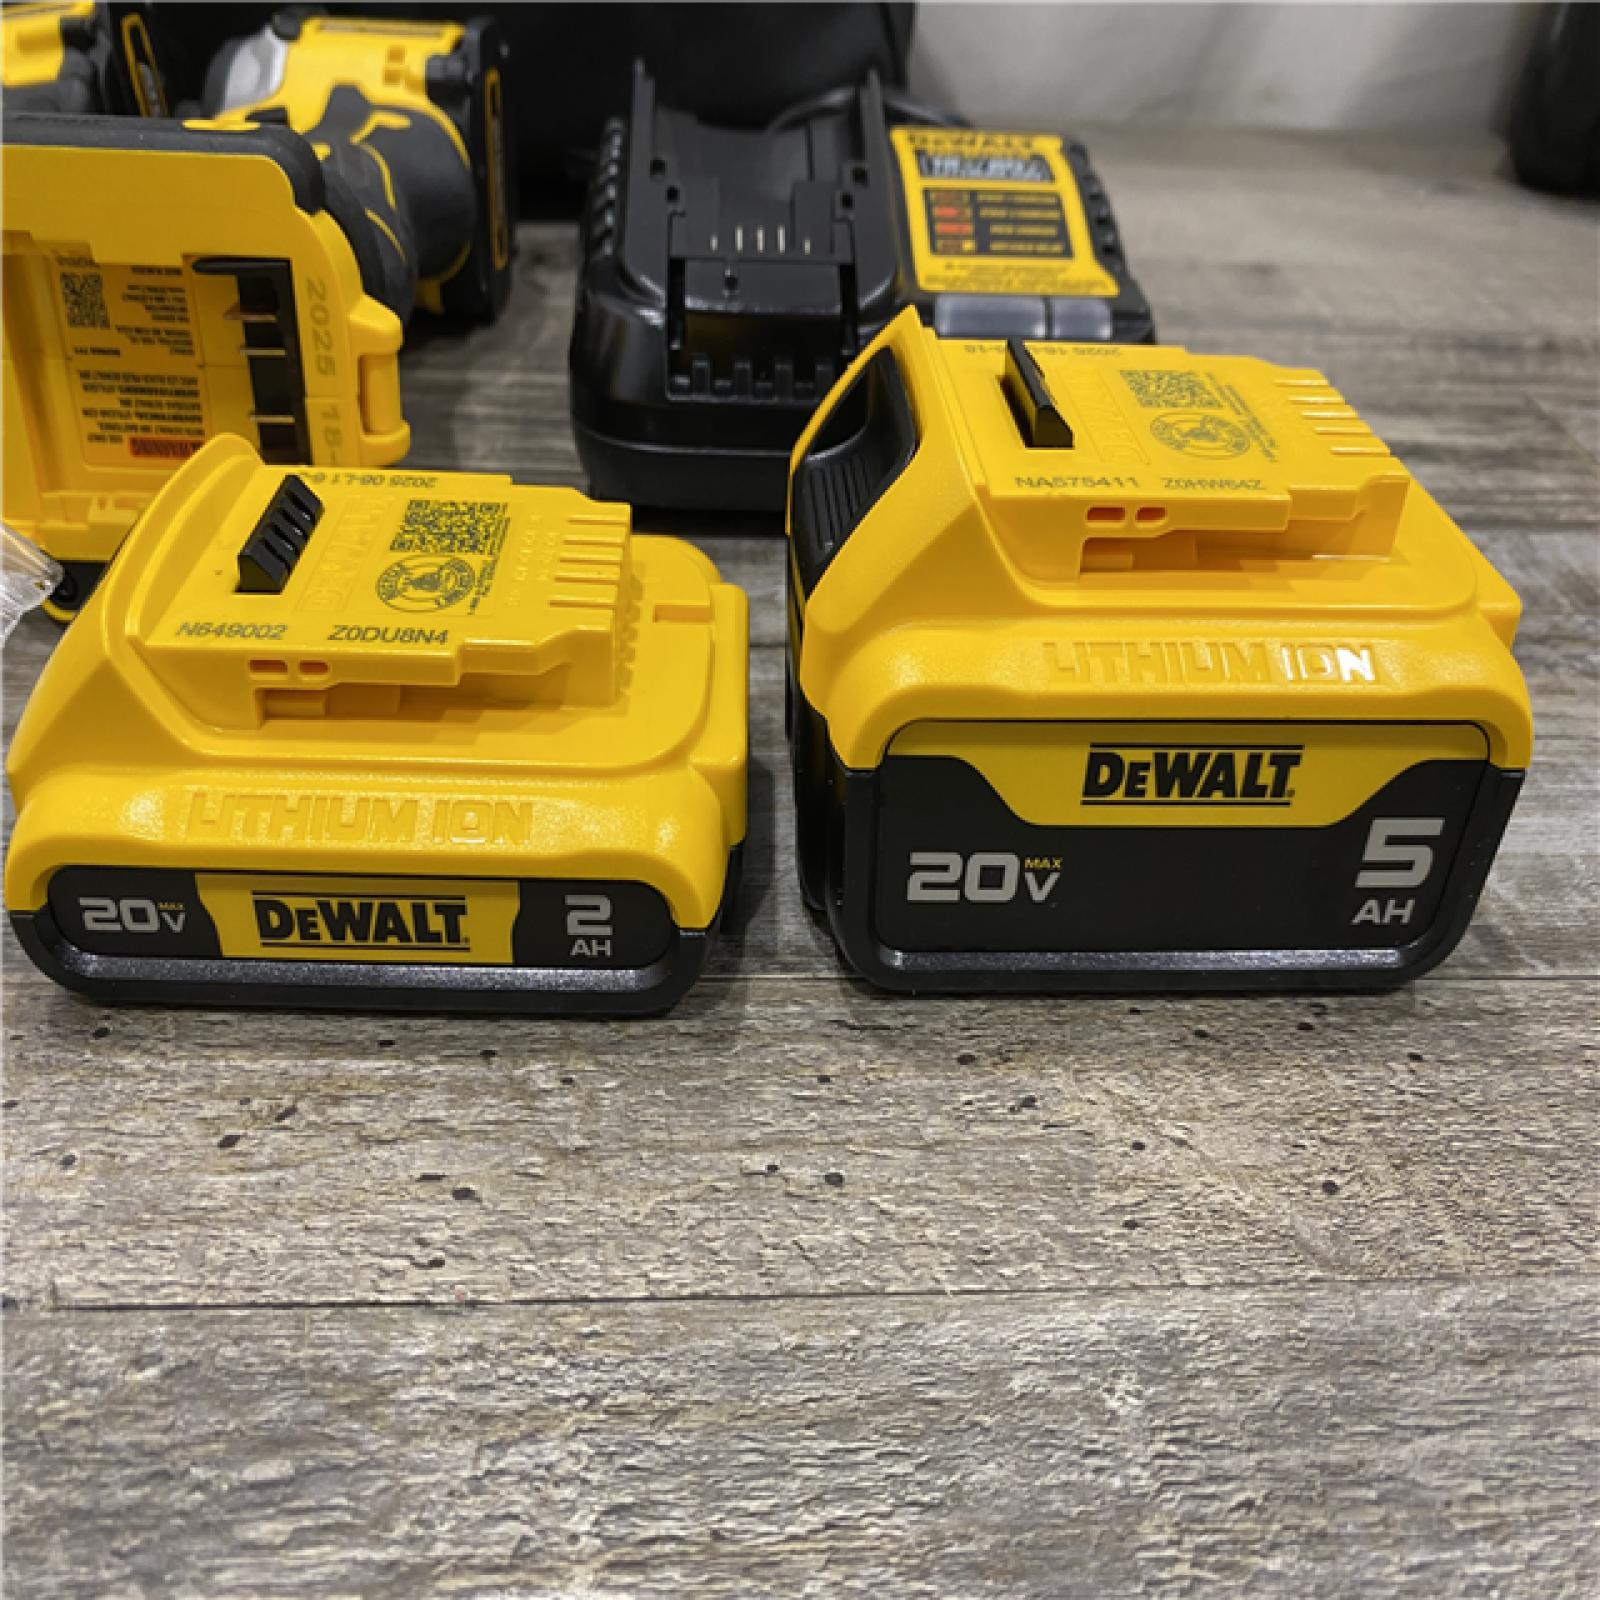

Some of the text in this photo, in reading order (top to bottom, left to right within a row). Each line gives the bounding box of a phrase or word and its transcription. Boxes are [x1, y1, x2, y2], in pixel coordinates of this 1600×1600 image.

[307, 277, 336, 378] 2025
[1043, 641, 1376, 683] LITHIUM ION
[186, 793, 534, 845] LITHIUM ION
[1024, 857, 1063, 869] MAX
[1355, 816, 1446, 888] 5
[564, 894, 614, 937] 2
[1351, 898, 1416, 926] AH
[569, 938, 612, 957] AH
